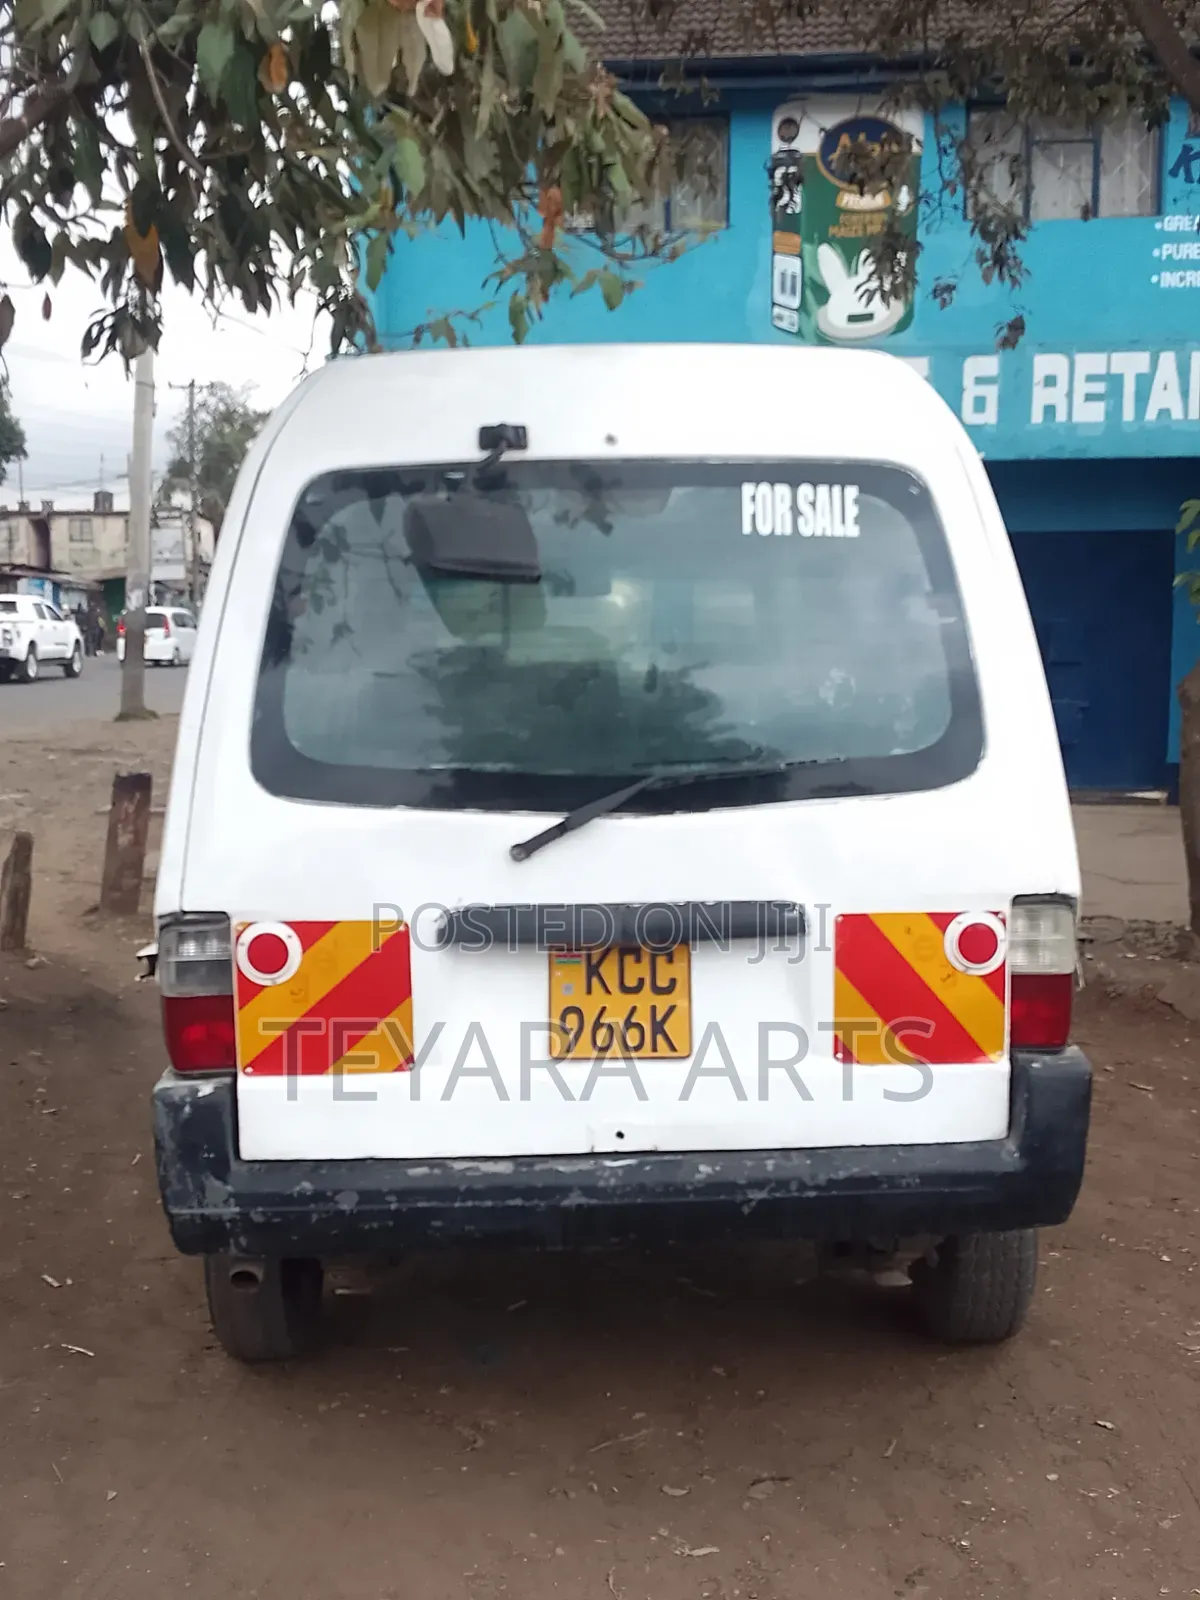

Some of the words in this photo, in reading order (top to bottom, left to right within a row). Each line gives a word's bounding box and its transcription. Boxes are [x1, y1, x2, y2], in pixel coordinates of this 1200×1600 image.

[1168, 143, 1200, 184] K
[1161, 242, 1200, 261] PURE
[961, 353, 999, 426] &
[741, 481, 793, 537] FOR
[796, 482, 860, 538] SALE
[585, 946, 678, 995] KCC
[559, 1003, 679, 1054] 966K
